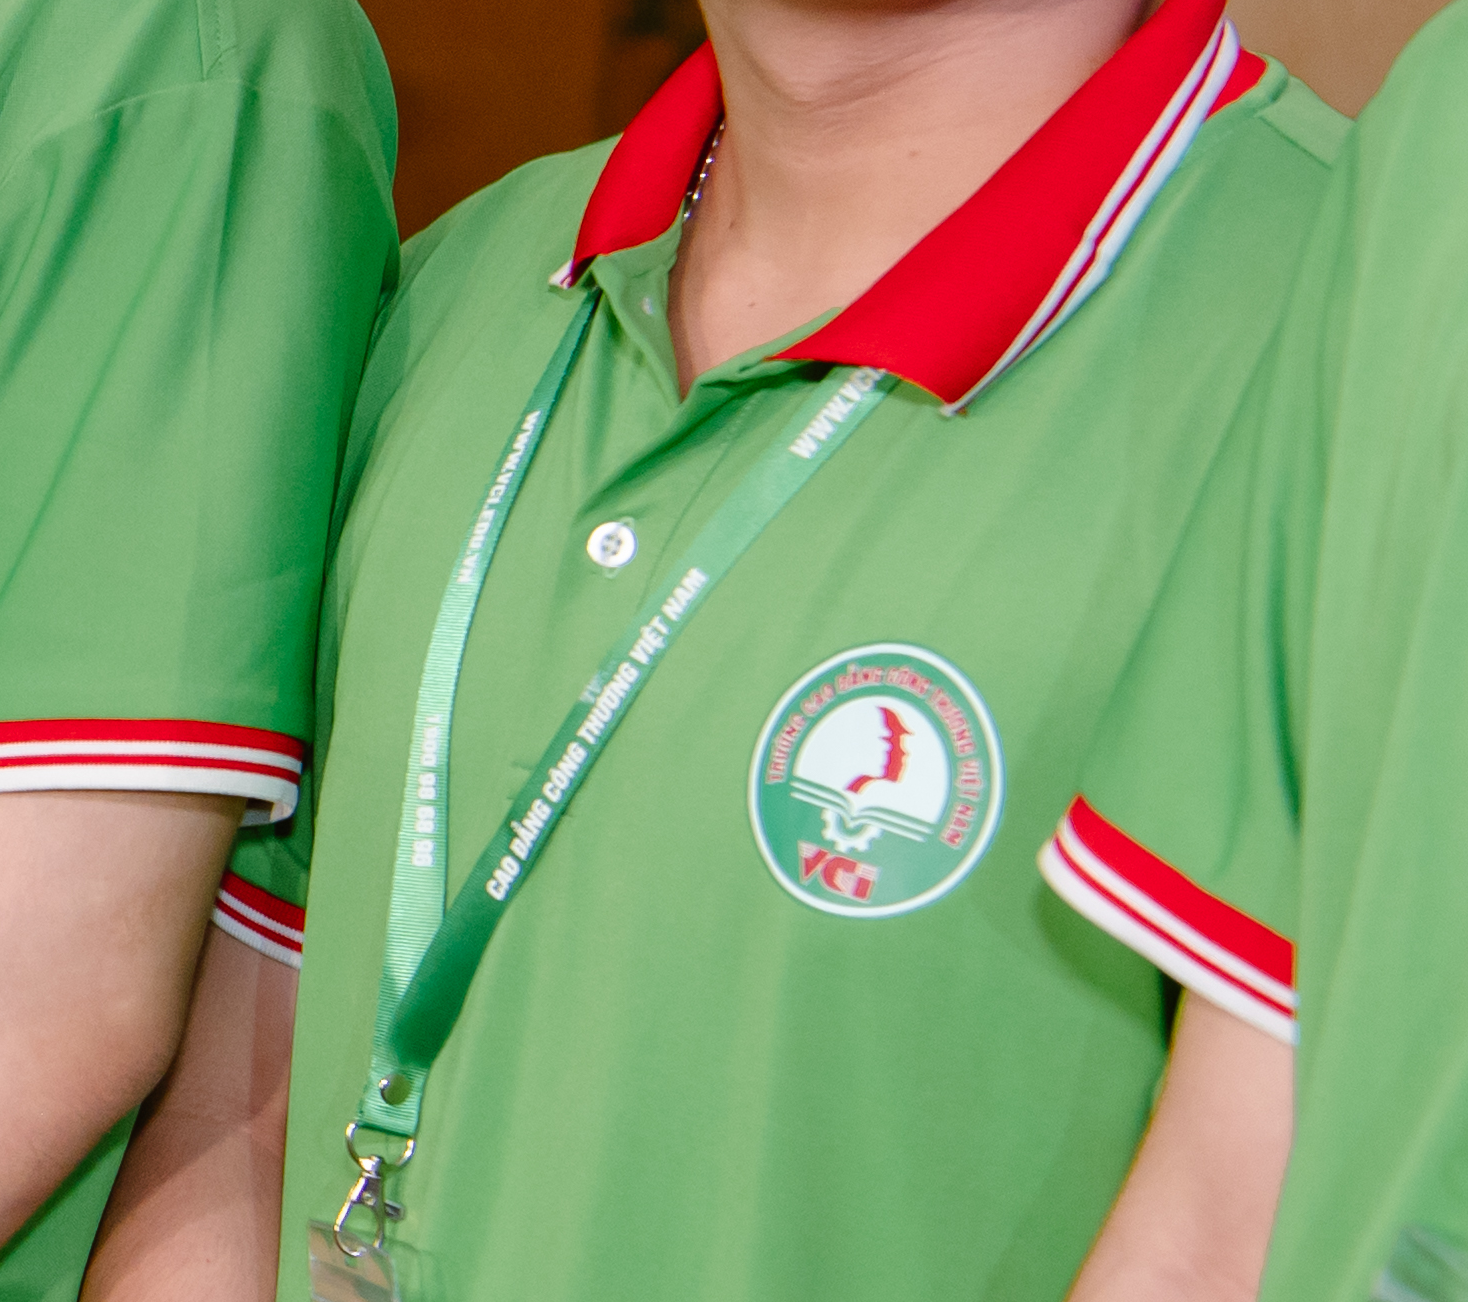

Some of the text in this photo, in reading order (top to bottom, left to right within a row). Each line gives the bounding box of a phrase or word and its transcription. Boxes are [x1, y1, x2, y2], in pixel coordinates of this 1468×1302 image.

[485, 855, 522, 901] CAO
[542, 742, 589, 803] CÔNG
[576, 661, 641, 744] THƯƠNG
[628, 615, 671, 665] VIỆT
[661, 567, 710, 621] NAM
